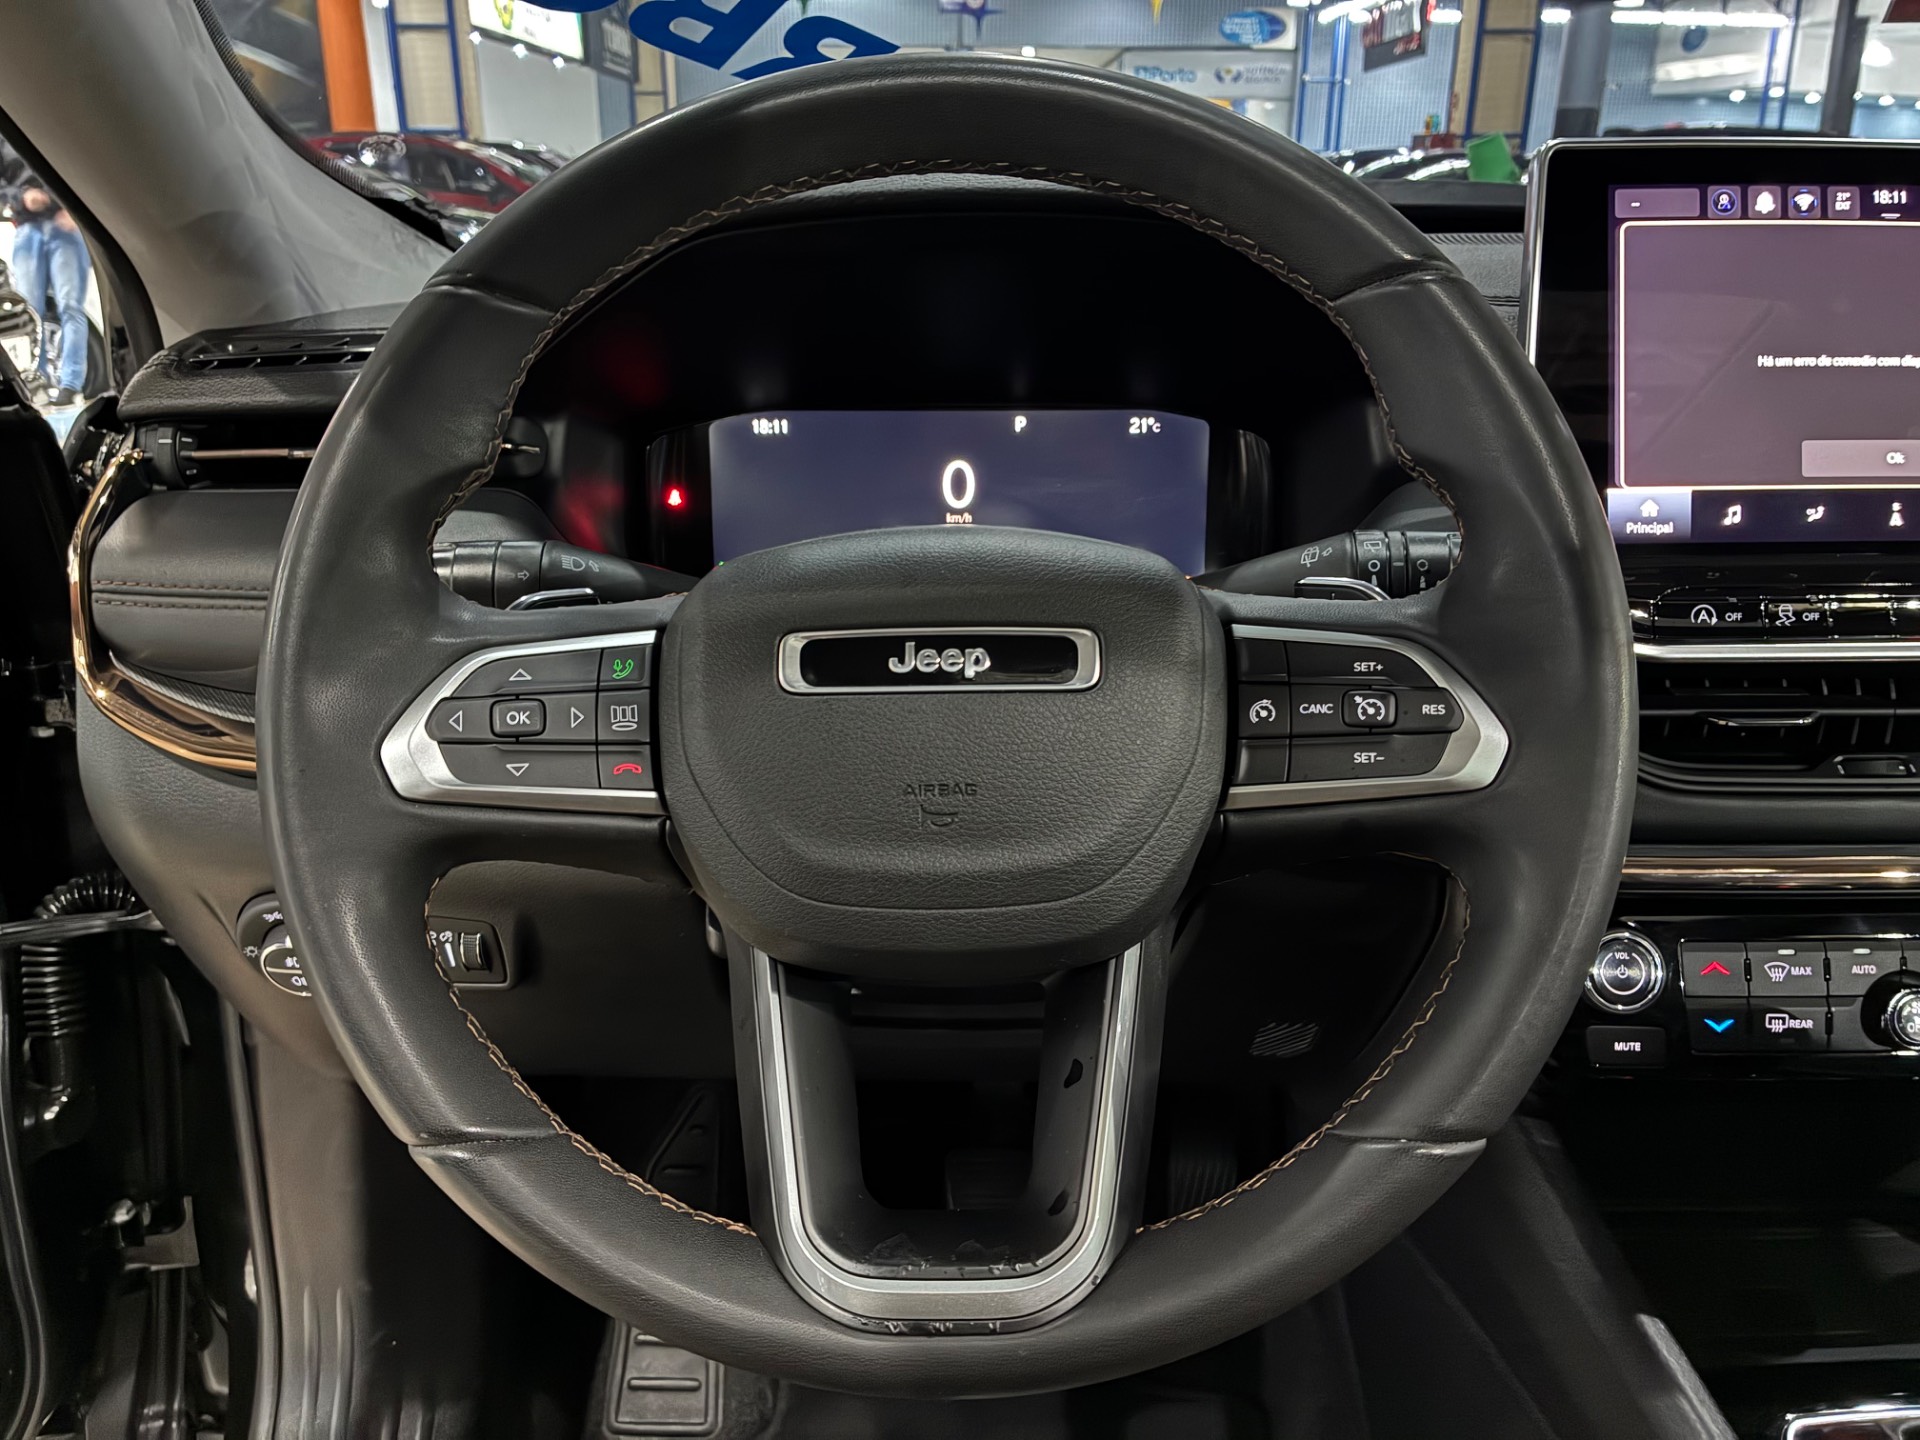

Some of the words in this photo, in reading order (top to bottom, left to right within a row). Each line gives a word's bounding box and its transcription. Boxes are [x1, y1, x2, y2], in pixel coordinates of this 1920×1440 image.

[1873, 190, 1907, 204] 18:11
[1757, 355, 1774, 367] Há
[1775, 357, 1793, 367] um
[1793, 357, 1817, 367] erro
[1817, 355, 1832, 367] de
[1877, 357, 1901, 367] com
[751, 418, 788, 434] 18:11
[1014, 415, 1027, 433] P
[1886, 452, 1905, 464] Ok
[942, 459, 975, 509] 0
[945, 512, 972, 523] km/h
[1626, 521, 1674, 536] Principal
[1725, 612, 1743, 622] OFF
[1802, 611, 1821, 622] OFF
[888, 641, 991, 679] Jeep
[1353, 661, 1385, 673] SET+
[1299, 703, 1334, 715] CANC
[1422, 704, 1446, 716] RES
[506, 710, 531, 725] OK
[1353, 752, 1386, 765] SET-
[902, 782, 979, 799] AIRBAG
[1614, 951, 1631, 960] VOL
[1790, 966, 1813, 976] MAX
[1851, 964, 1877, 975] AUTO
[1789, 1018, 1814, 1030] REAR
[1613, 1041, 1642, 1053] MUTE
